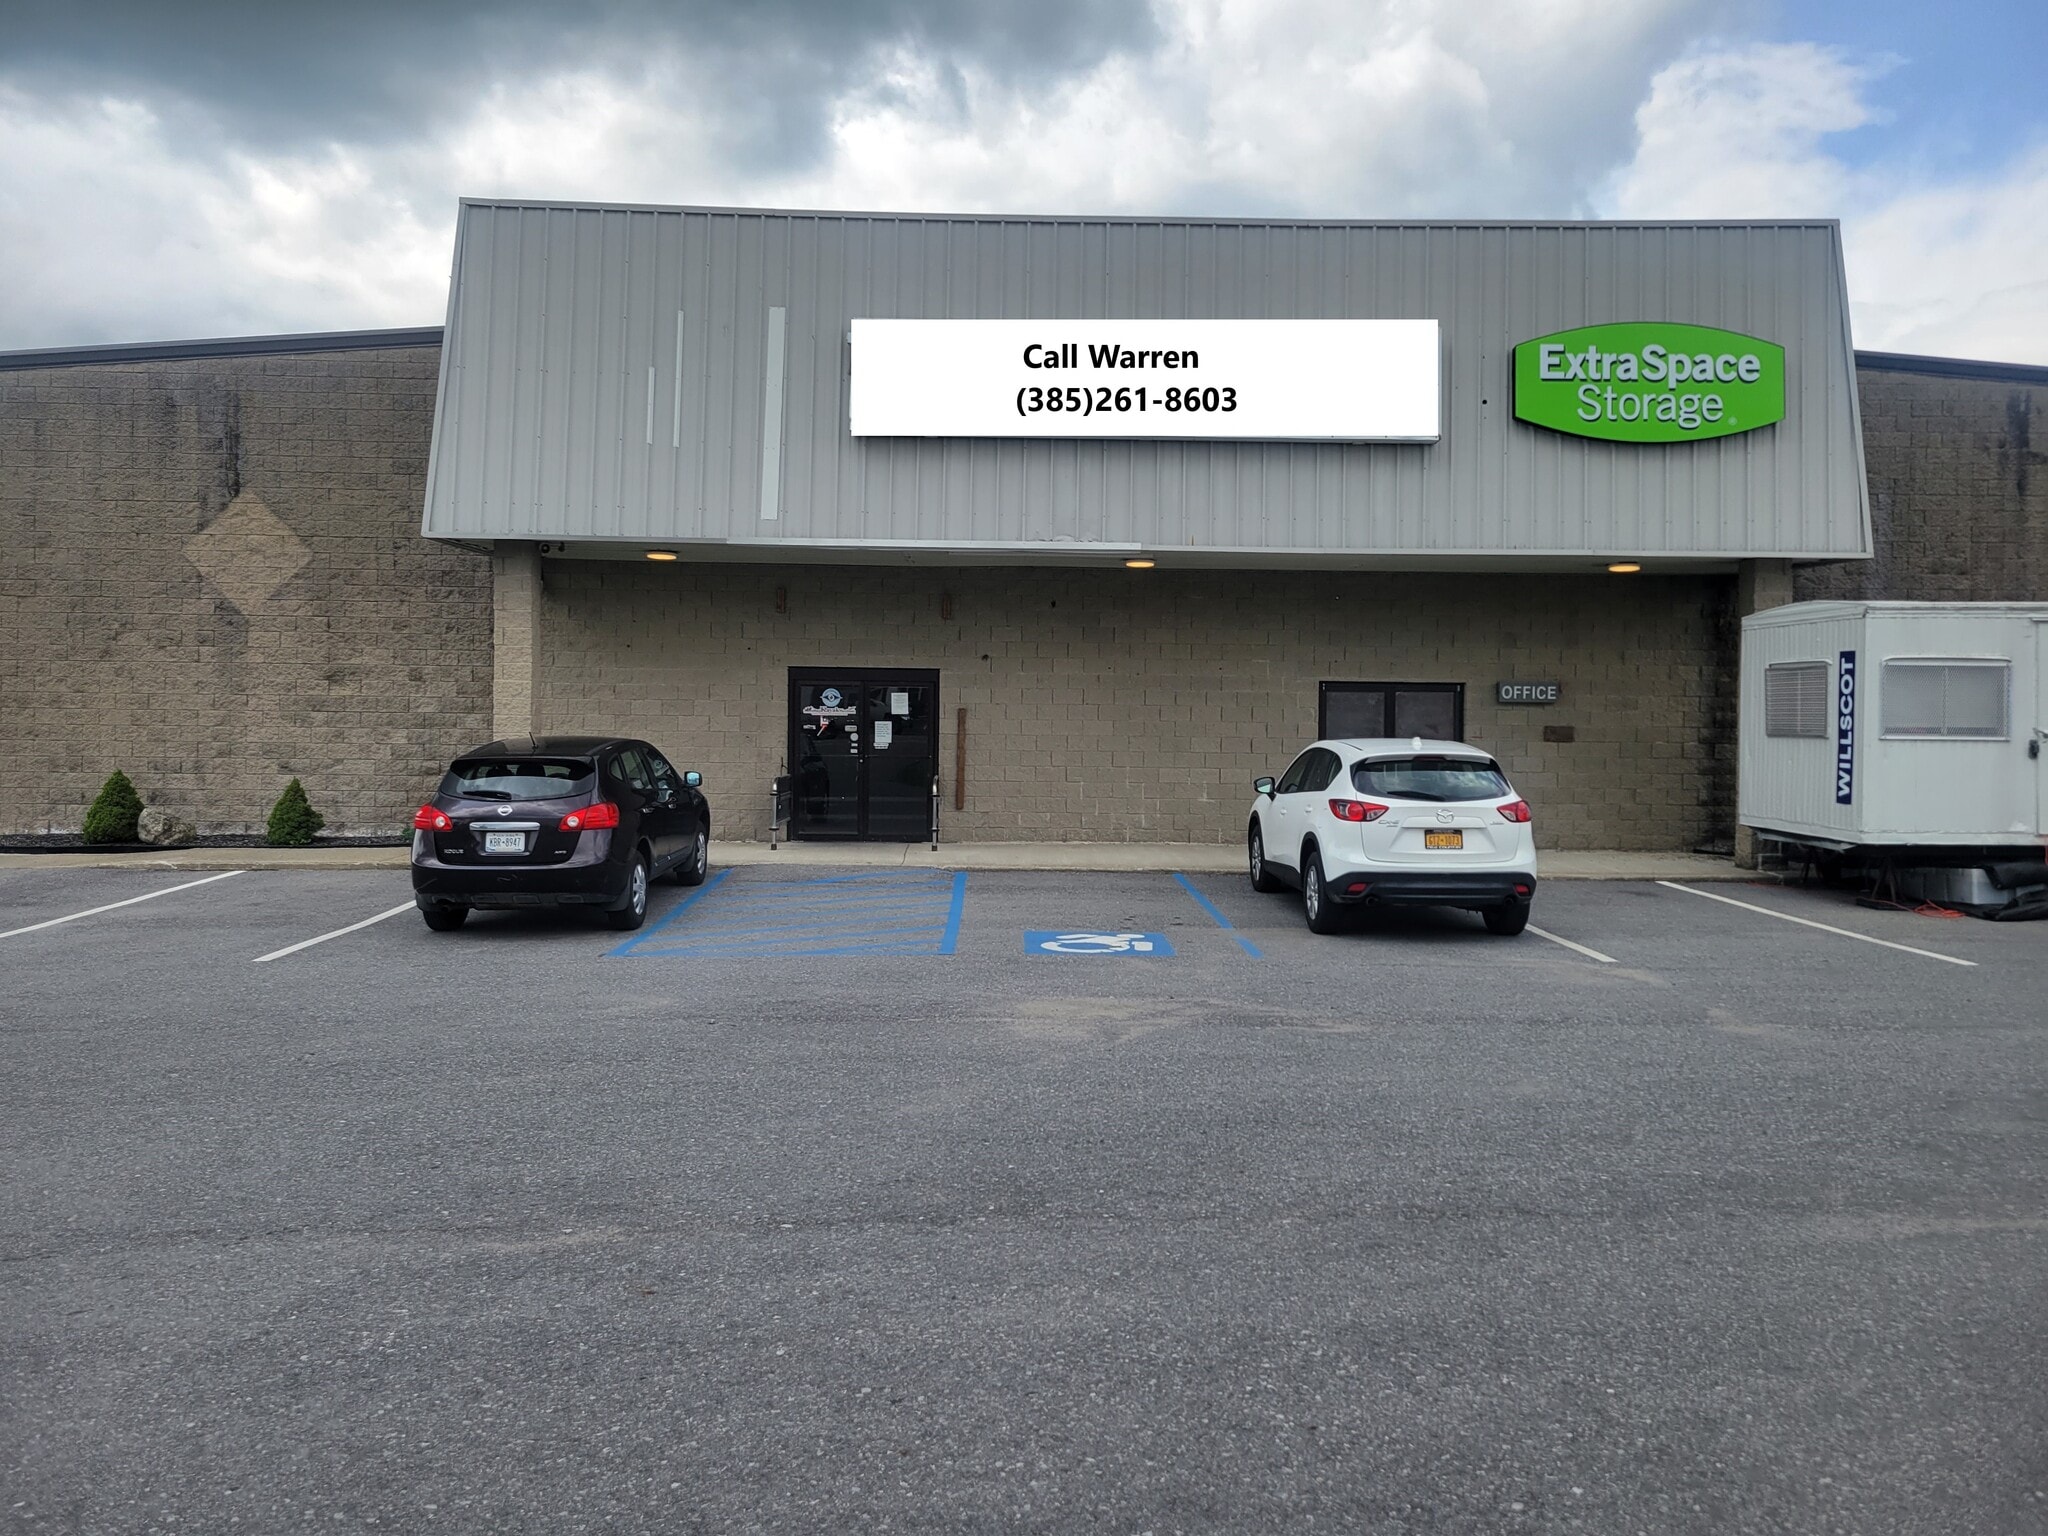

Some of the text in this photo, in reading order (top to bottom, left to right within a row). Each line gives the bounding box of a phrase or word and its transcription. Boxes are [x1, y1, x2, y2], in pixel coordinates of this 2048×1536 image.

[1577, 384, 1723, 429] Storage
[1501, 685, 1557, 700] OFFICE
[1837, 657, 1854, 797] WILLSCOT
